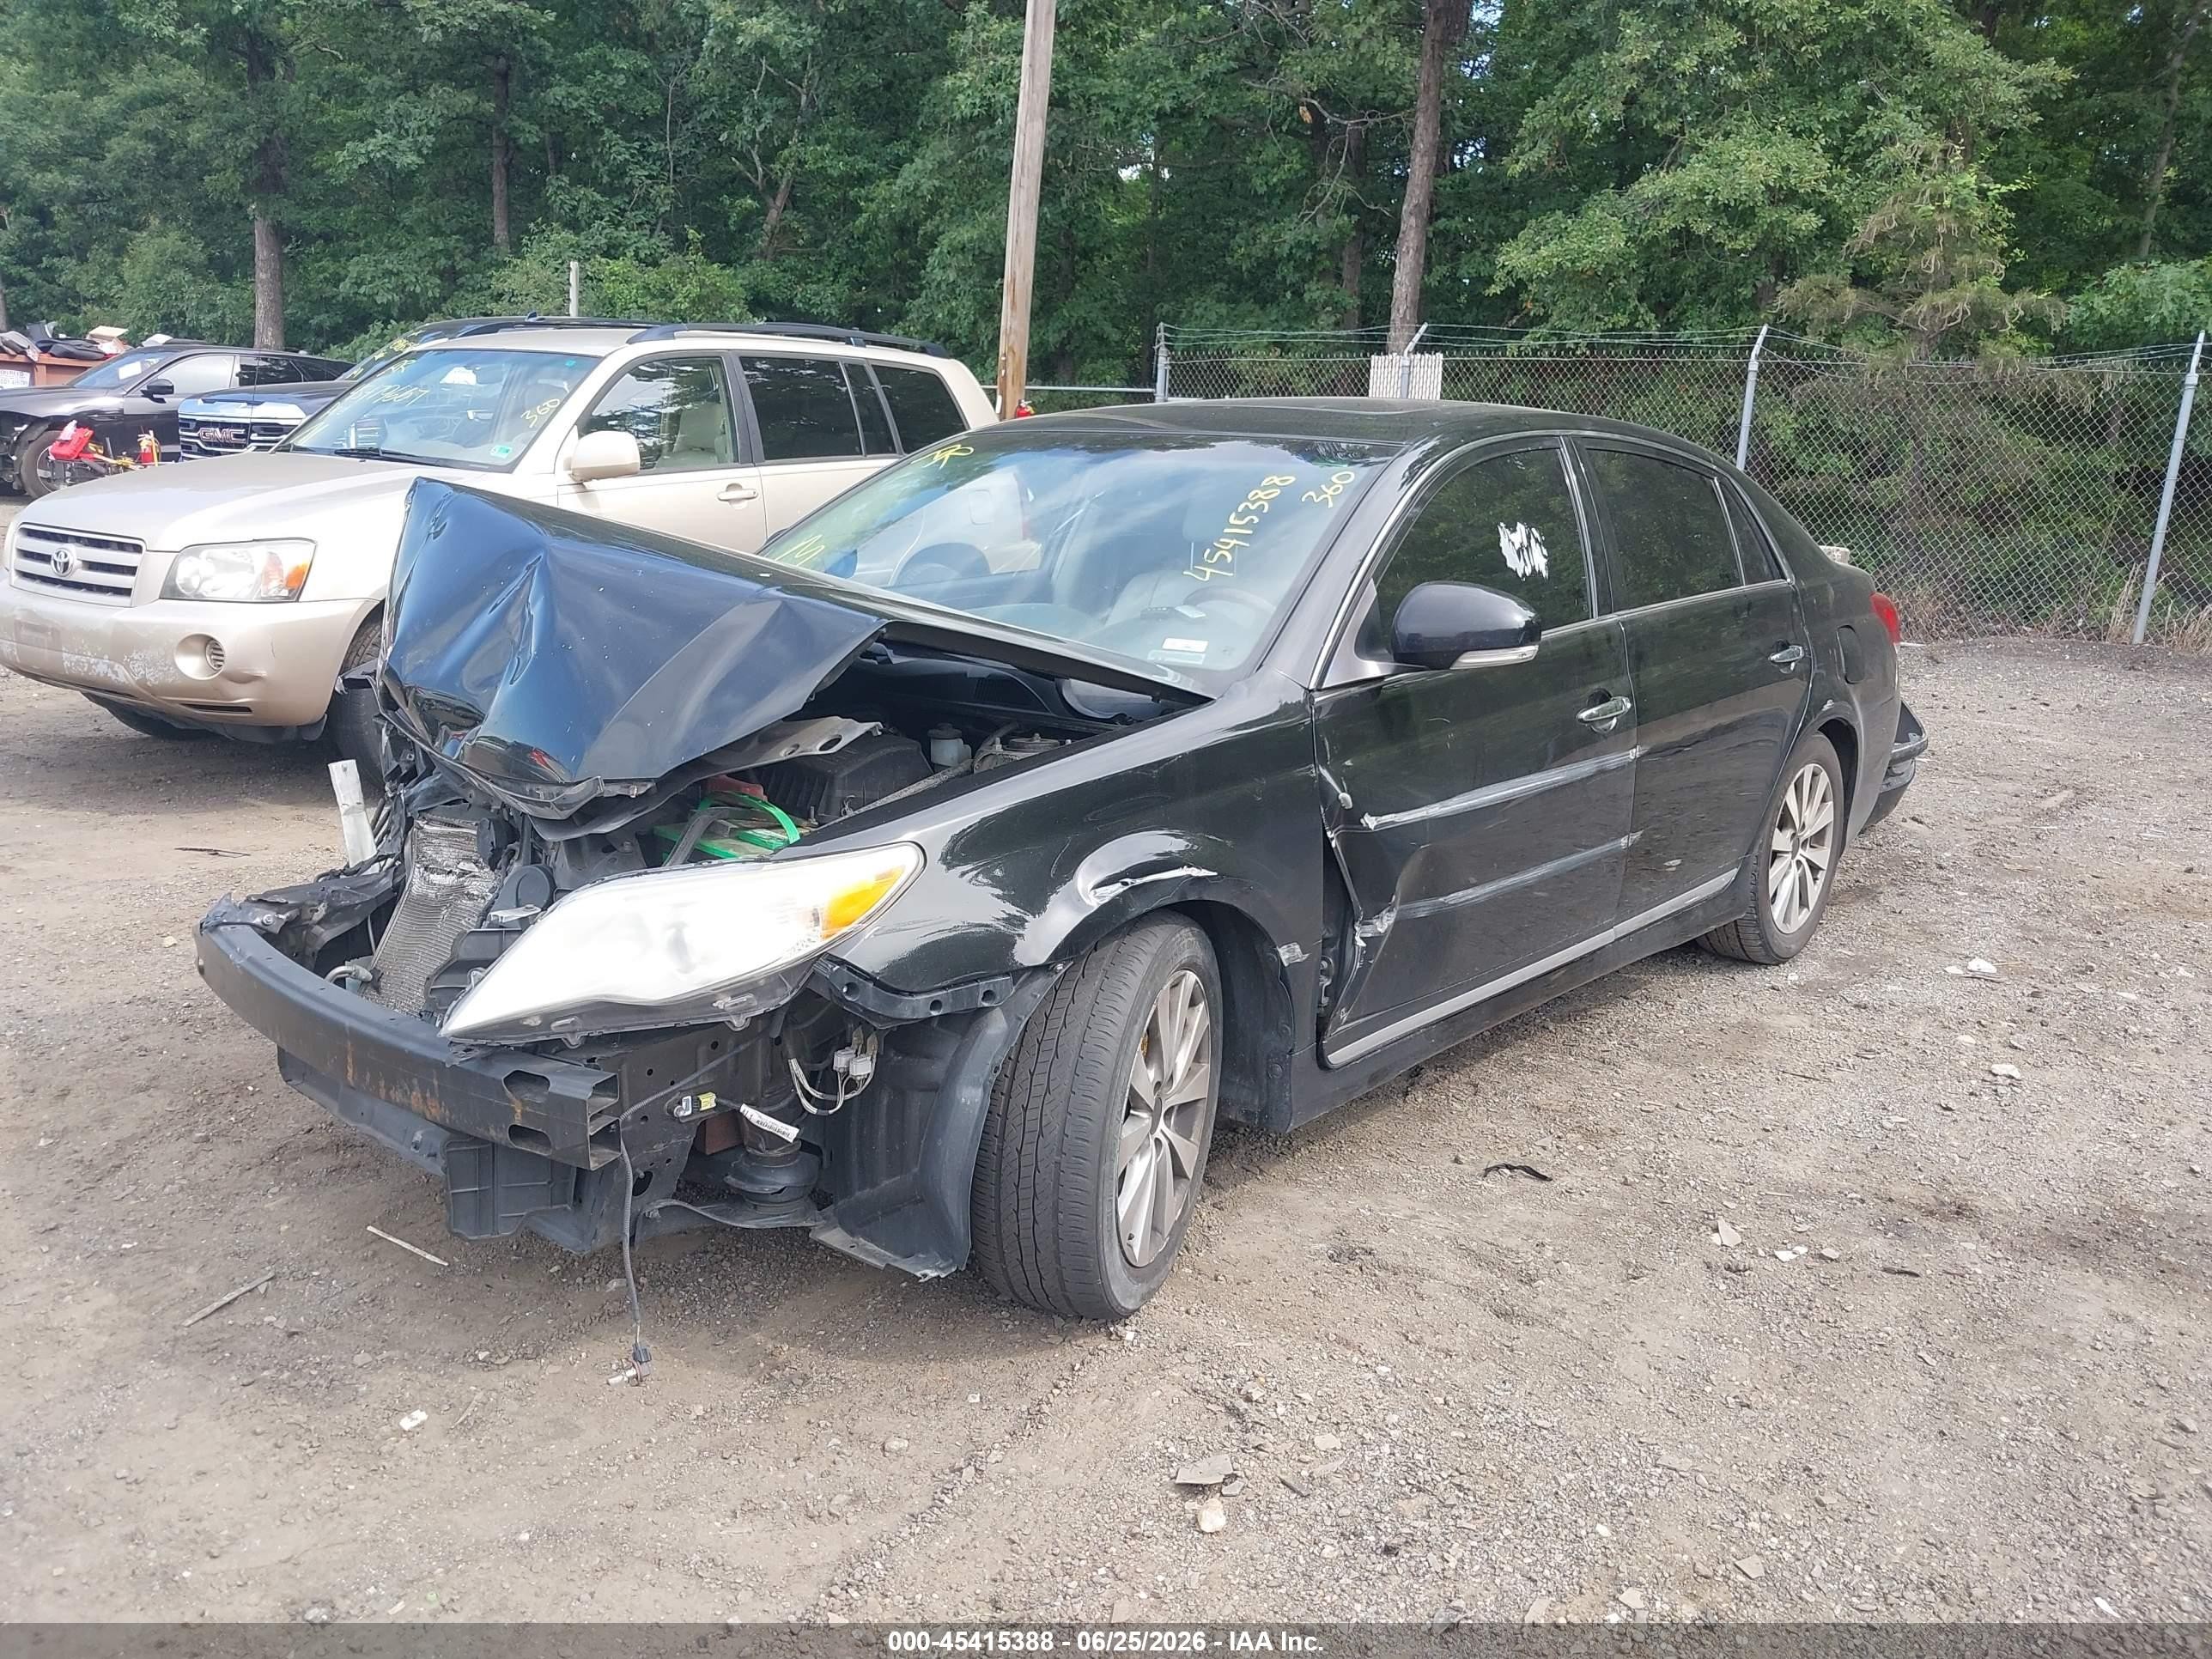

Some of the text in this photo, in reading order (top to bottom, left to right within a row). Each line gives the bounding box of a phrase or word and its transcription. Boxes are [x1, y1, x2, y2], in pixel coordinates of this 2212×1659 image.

[520, 398, 561, 428] 360
[200, 428, 246, 443] GMC
[1301, 471, 1356, 509] 360
[1182, 475, 1297, 582] 45415388
